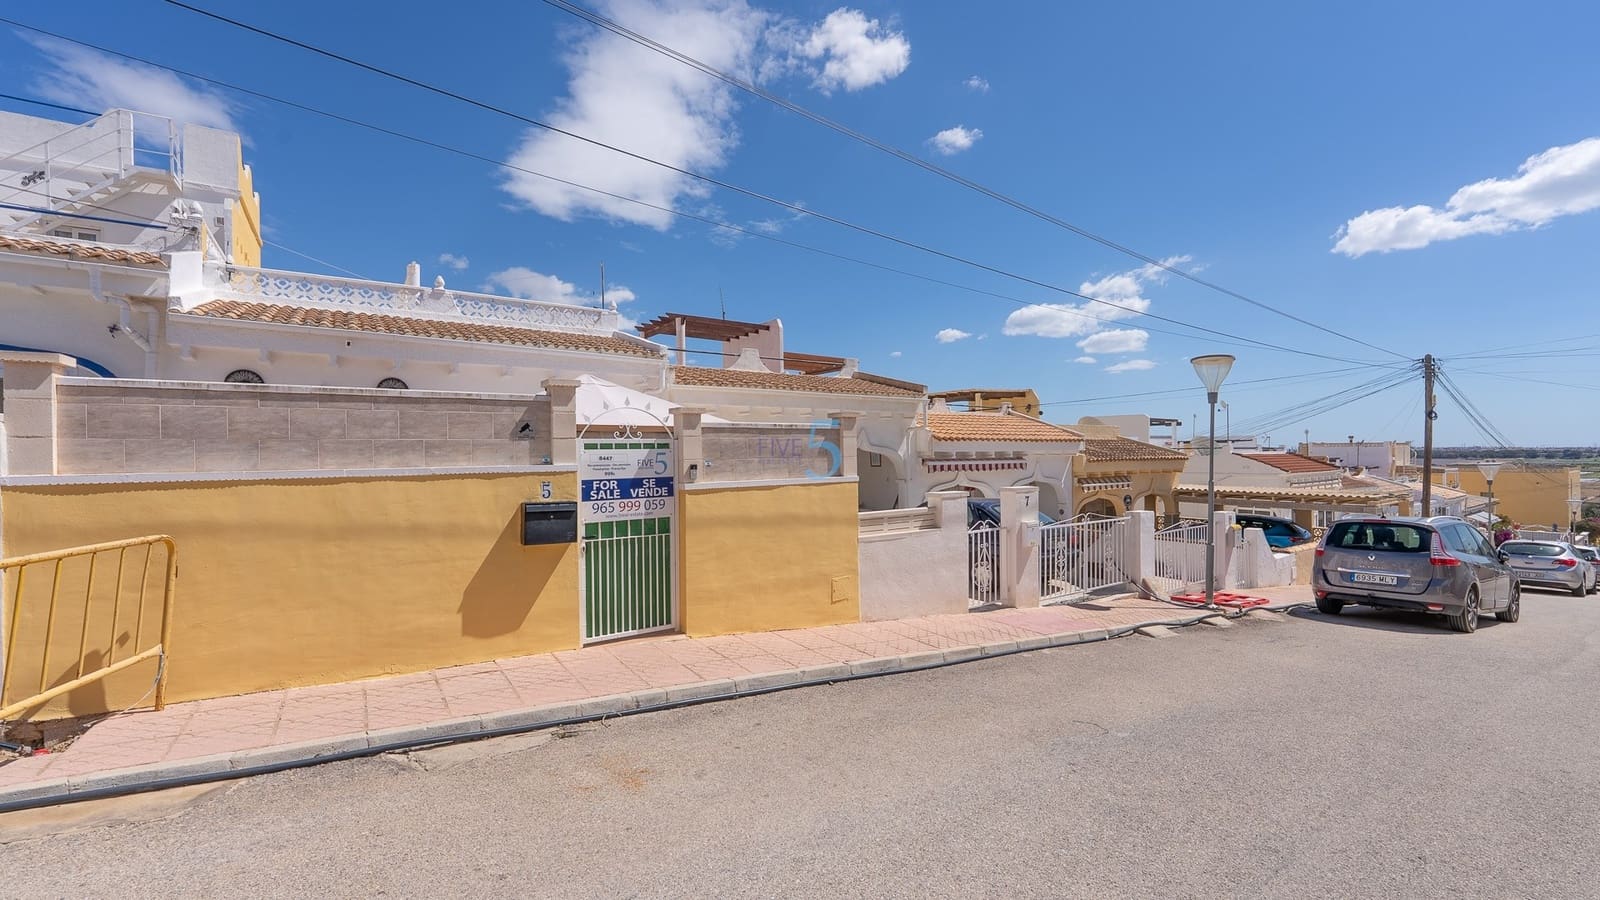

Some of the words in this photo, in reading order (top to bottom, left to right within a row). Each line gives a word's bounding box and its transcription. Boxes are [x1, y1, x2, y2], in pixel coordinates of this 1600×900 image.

[637, 458, 654, 467] FIVE
[654, 452, 668, 475] 5
[593, 481, 618, 490] FOR
[642, 479, 656, 488] SE
[542, 483, 551, 499] 5
[590, 490, 621, 500] SALE
[630, 487, 668, 498] VENDE
[592, 501, 615, 514] 965
[618, 500, 641, 512] 999
[643, 498, 666, 510] 059
[1025, 496, 1030, 507] 7
[1356, 574, 1377, 582] 6935
[1378, 576, 1395, 584] MLY
